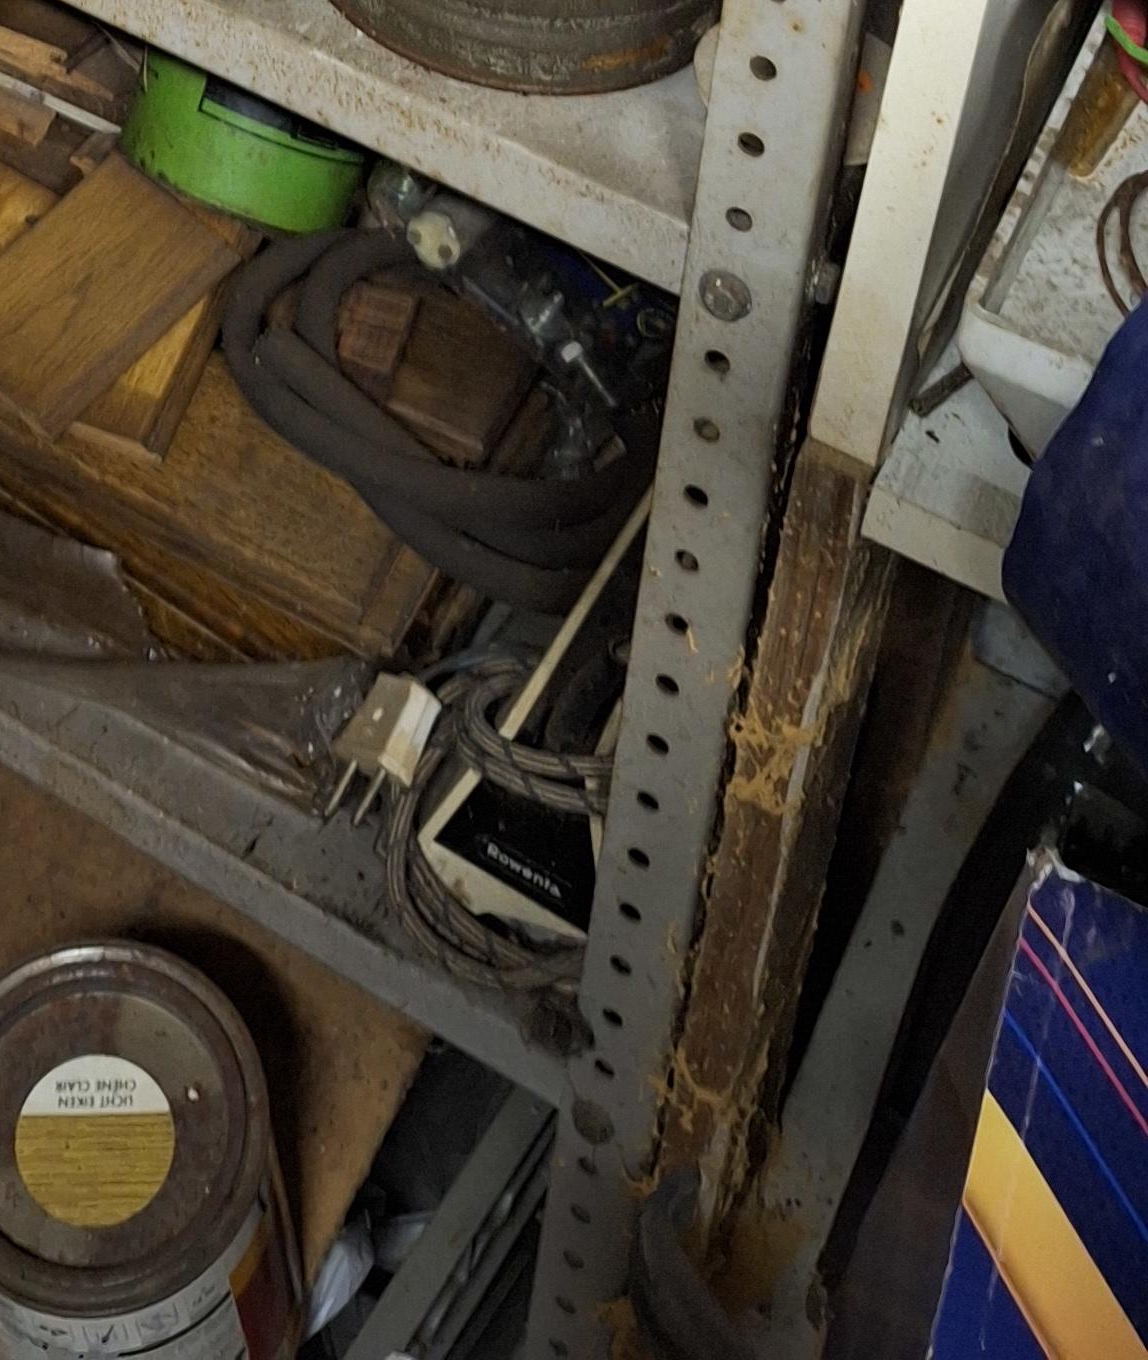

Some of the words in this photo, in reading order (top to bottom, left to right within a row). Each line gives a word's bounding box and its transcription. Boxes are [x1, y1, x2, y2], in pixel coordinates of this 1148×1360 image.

[486, 841, 562, 899] Rowenta
[55, 1080, 91, 1092] CLAIR
[57, 1095, 95, 1109] EIKEN
[99, 1094, 134, 1109] LICHT
